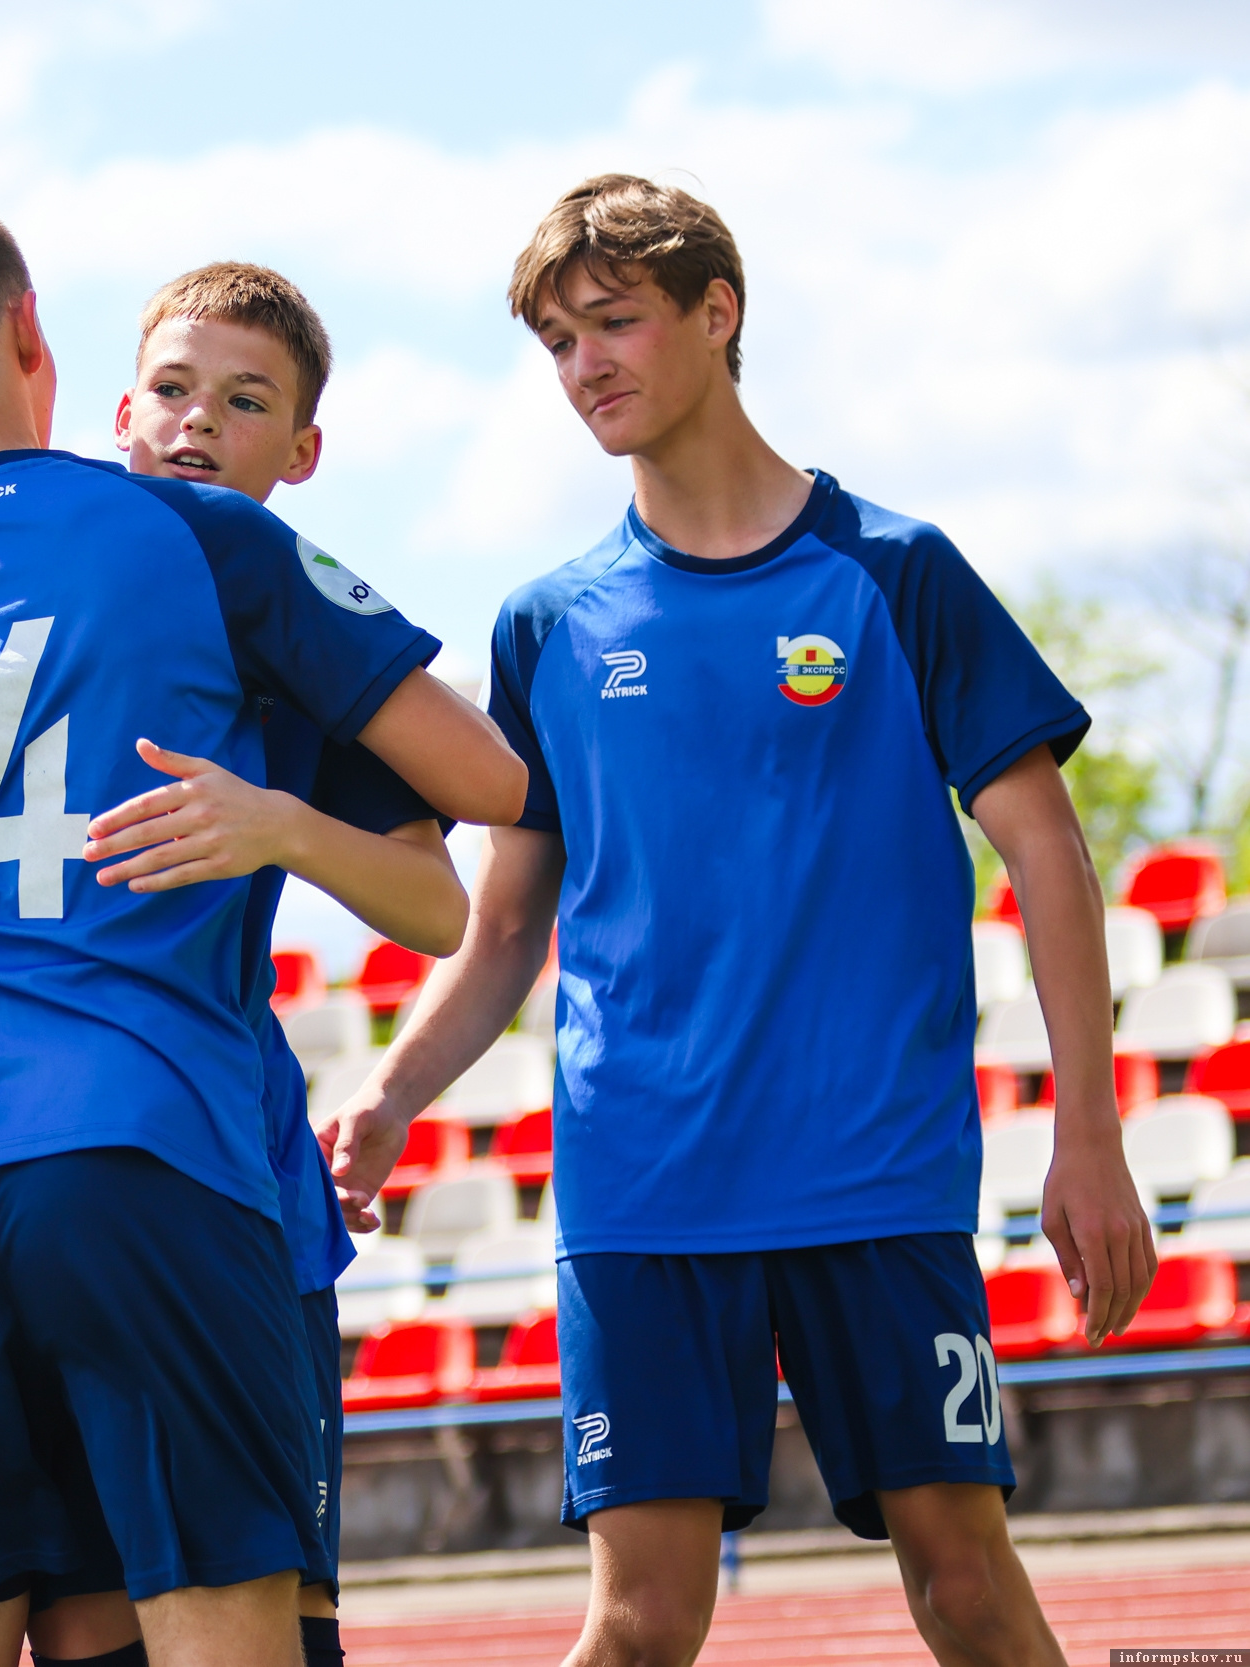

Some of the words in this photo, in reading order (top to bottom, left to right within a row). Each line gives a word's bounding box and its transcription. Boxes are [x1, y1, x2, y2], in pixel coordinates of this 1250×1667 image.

[802, 666, 846, 675] ЭКСПРЕСС
[601, 685, 648, 700] PATRICK
[934, 1333, 1001, 1446] 20
[577, 1446, 613, 1467] PATRICK
